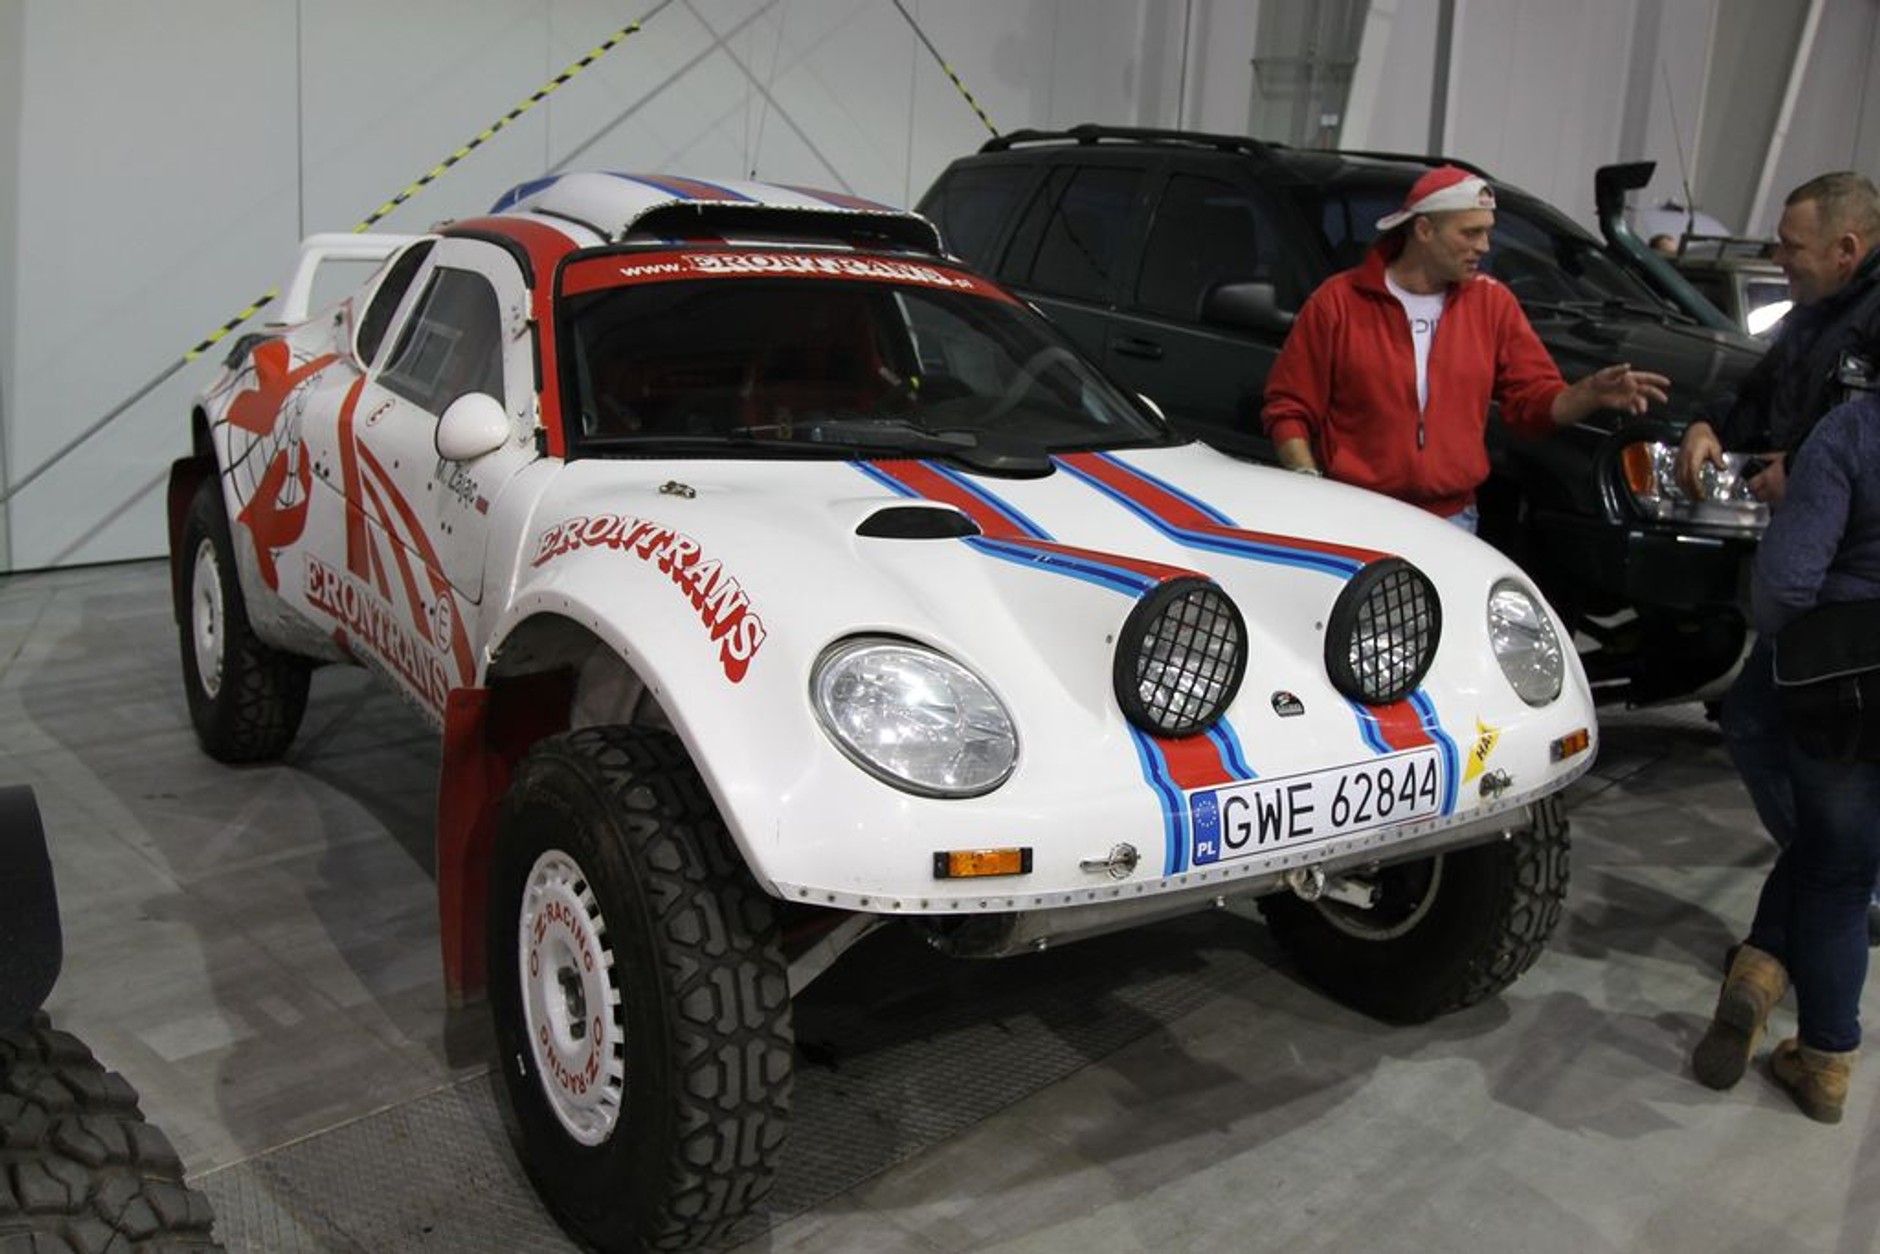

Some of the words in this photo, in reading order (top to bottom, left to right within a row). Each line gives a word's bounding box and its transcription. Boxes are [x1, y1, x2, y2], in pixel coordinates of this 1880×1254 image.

[304, 552, 450, 716] ERONTRANS
[530, 514, 768, 684] ERONTRANS
[1197, 841, 1217, 858] PL
[1223, 782, 1314, 849] GWE
[1330, 758, 1437, 828] 62844
